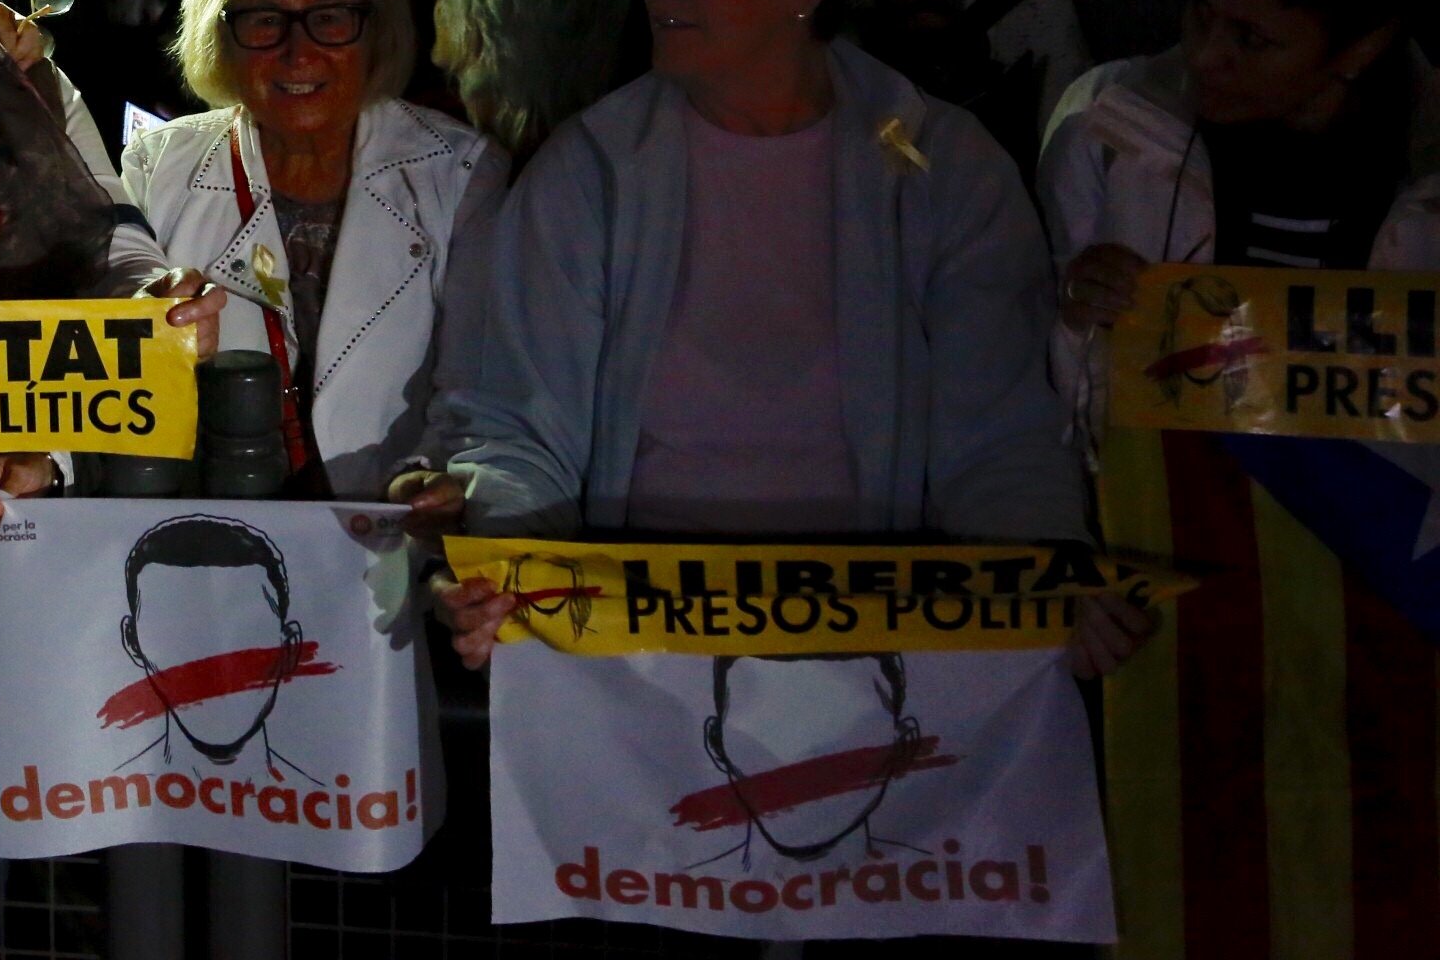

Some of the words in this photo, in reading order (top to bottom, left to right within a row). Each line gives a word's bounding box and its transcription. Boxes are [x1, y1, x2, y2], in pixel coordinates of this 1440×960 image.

[627, 589, 859, 635] PRESOS
[0, 765, 417, 830] democràcia!
[555, 840, 1051, 914] democràcia!
